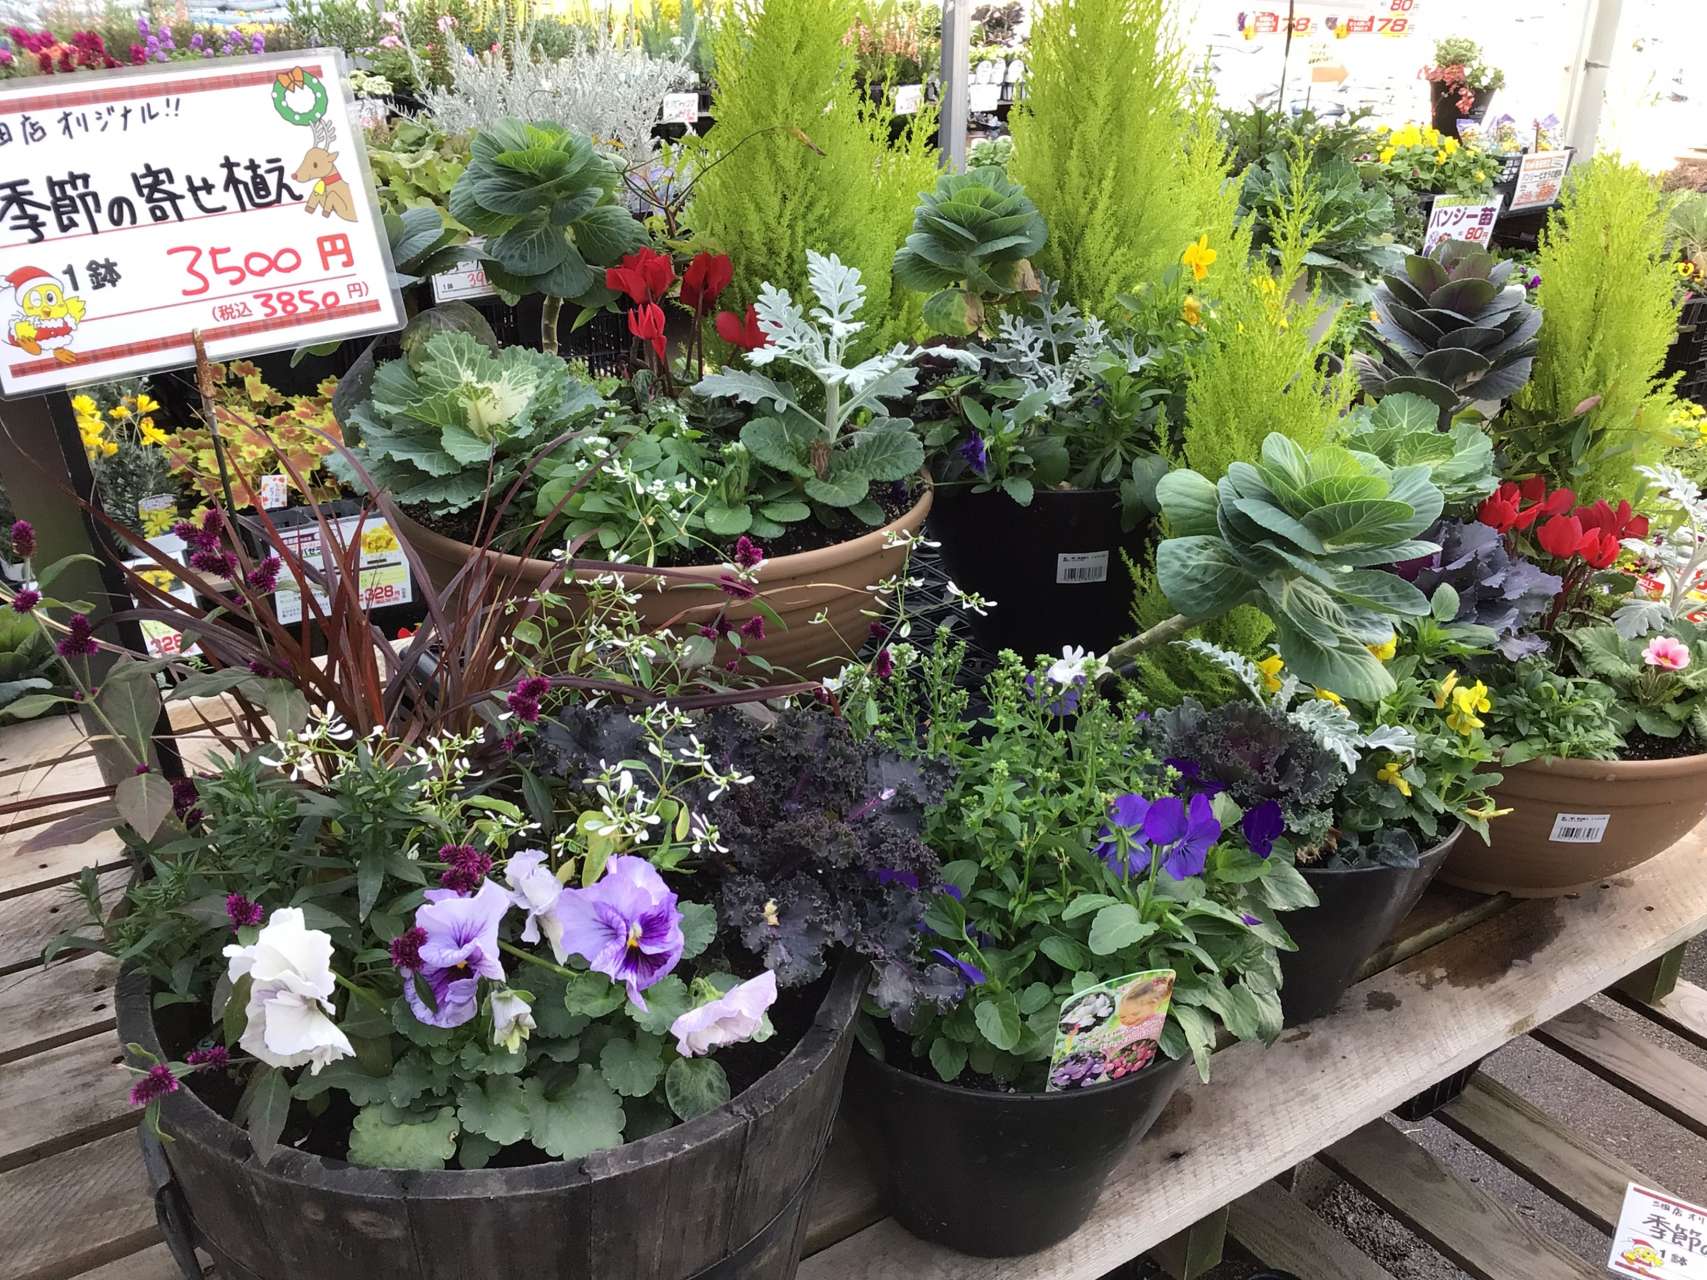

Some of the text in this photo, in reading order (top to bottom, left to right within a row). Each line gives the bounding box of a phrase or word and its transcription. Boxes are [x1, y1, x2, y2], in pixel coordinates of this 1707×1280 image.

[0, 155, 304, 243] 季節の寄せ植え
[467, 271, 486, 288] 39
